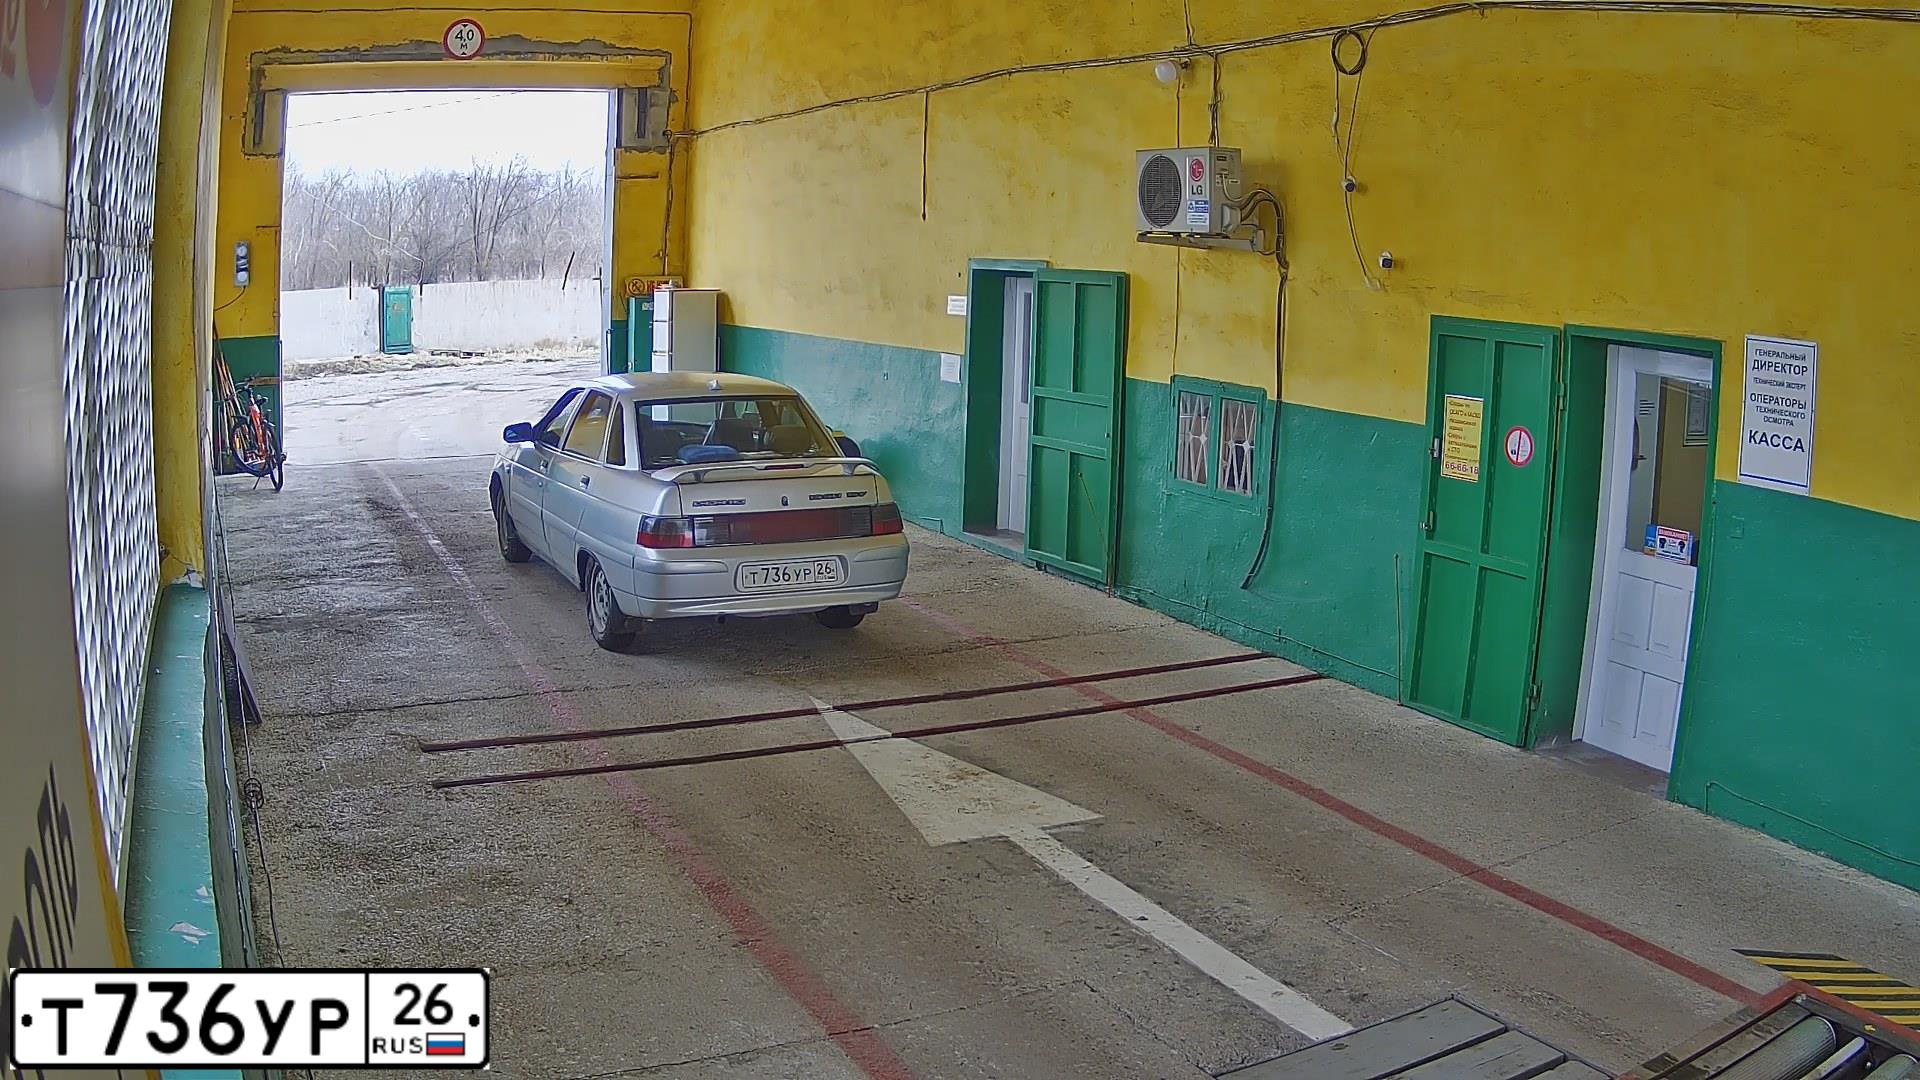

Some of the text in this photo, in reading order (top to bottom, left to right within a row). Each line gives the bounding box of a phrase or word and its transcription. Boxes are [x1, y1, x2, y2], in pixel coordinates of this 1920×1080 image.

[455, 29, 474, 42] 4,0
[1191, 185, 1203, 195] LG
[1755, 348, 1806, 361] ГЕНЕРАЛЬНЫЙ
[1752, 359, 1808, 376] ДИРЕКТОР
[1750, 393, 1807, 410] ОПЕРАТОРЫ
[1756, 405, 1806, 419] ТЕХНИЧЕСКОГО
[1763, 415, 1794, 426] ОСМОТРА
[1749, 430, 1805, 453] КАССА
[817, 562, 831, 575] 26
